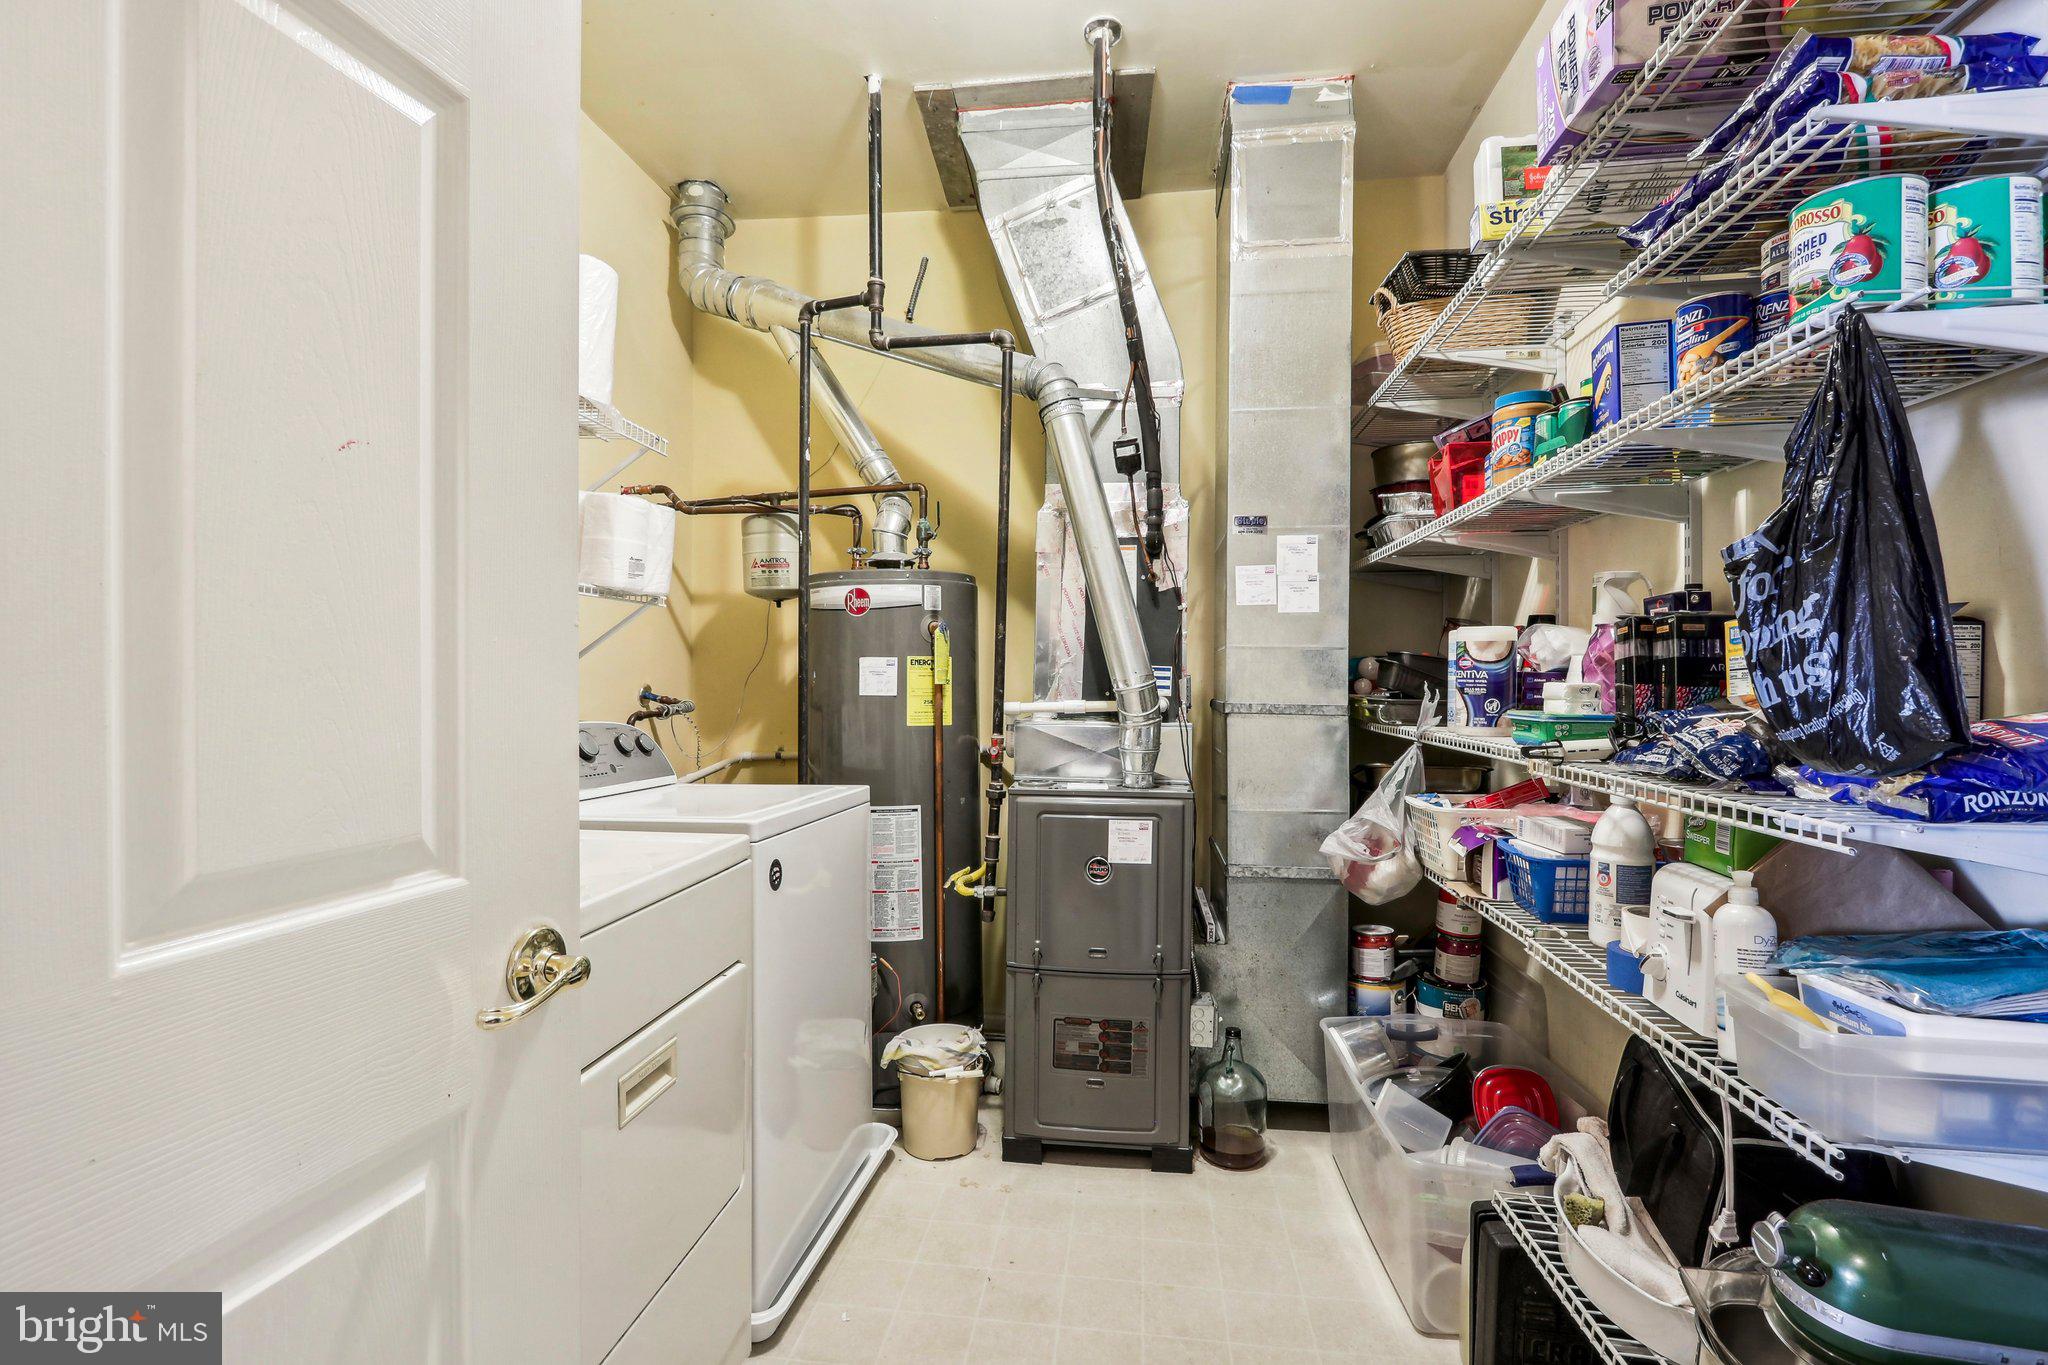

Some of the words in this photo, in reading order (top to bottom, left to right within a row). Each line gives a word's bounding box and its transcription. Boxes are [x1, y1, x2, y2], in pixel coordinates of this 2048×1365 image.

[1567, 13, 1578, 98] POWER
[1558, 43, 1568, 96] FLEX
[1793, 205, 1841, 231] OROSSO
[1756, 299, 1789, 321] RIENZ
[847, 588, 870, 612] Rheem
[1963, 789, 2048, 814] RONZON
[1685, 829, 1711, 846] SWEEPER
[1675, 989, 1698, 1009] Cuisinart
[1828, 1010, 1860, 1029] medium
[1859, 1021, 1874, 1035] bin
